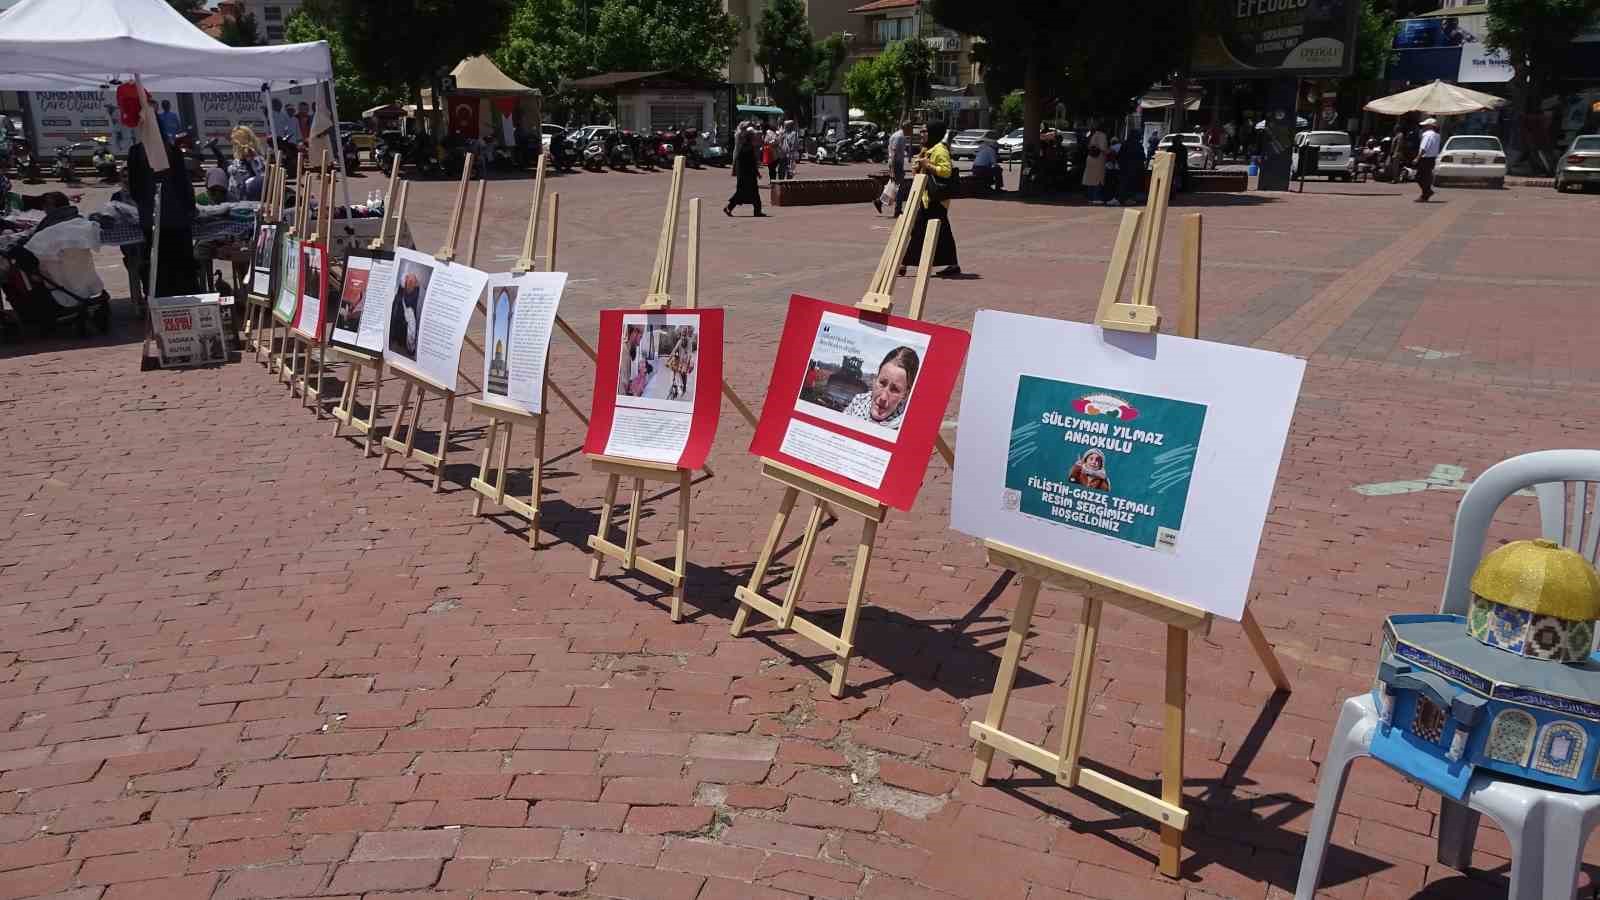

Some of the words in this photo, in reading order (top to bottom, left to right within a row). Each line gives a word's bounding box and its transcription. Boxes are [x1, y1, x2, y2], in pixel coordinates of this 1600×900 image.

[1041, 411, 1109, 435] SÜLEYMAN
[1113, 424, 1165, 446] YILMAZ
[1064, 430, 1133, 454] ANAOKULU
[1027, 475, 1108, 505] FİLİSTİN-GAZZE
[1112, 496, 1156, 517] TEMALI
[1041, 490, 1073, 509] RESİM
[1075, 500, 1135, 524] SERGİMİZE
[1051, 505, 1120, 532] HOŞGELDİNİZ
